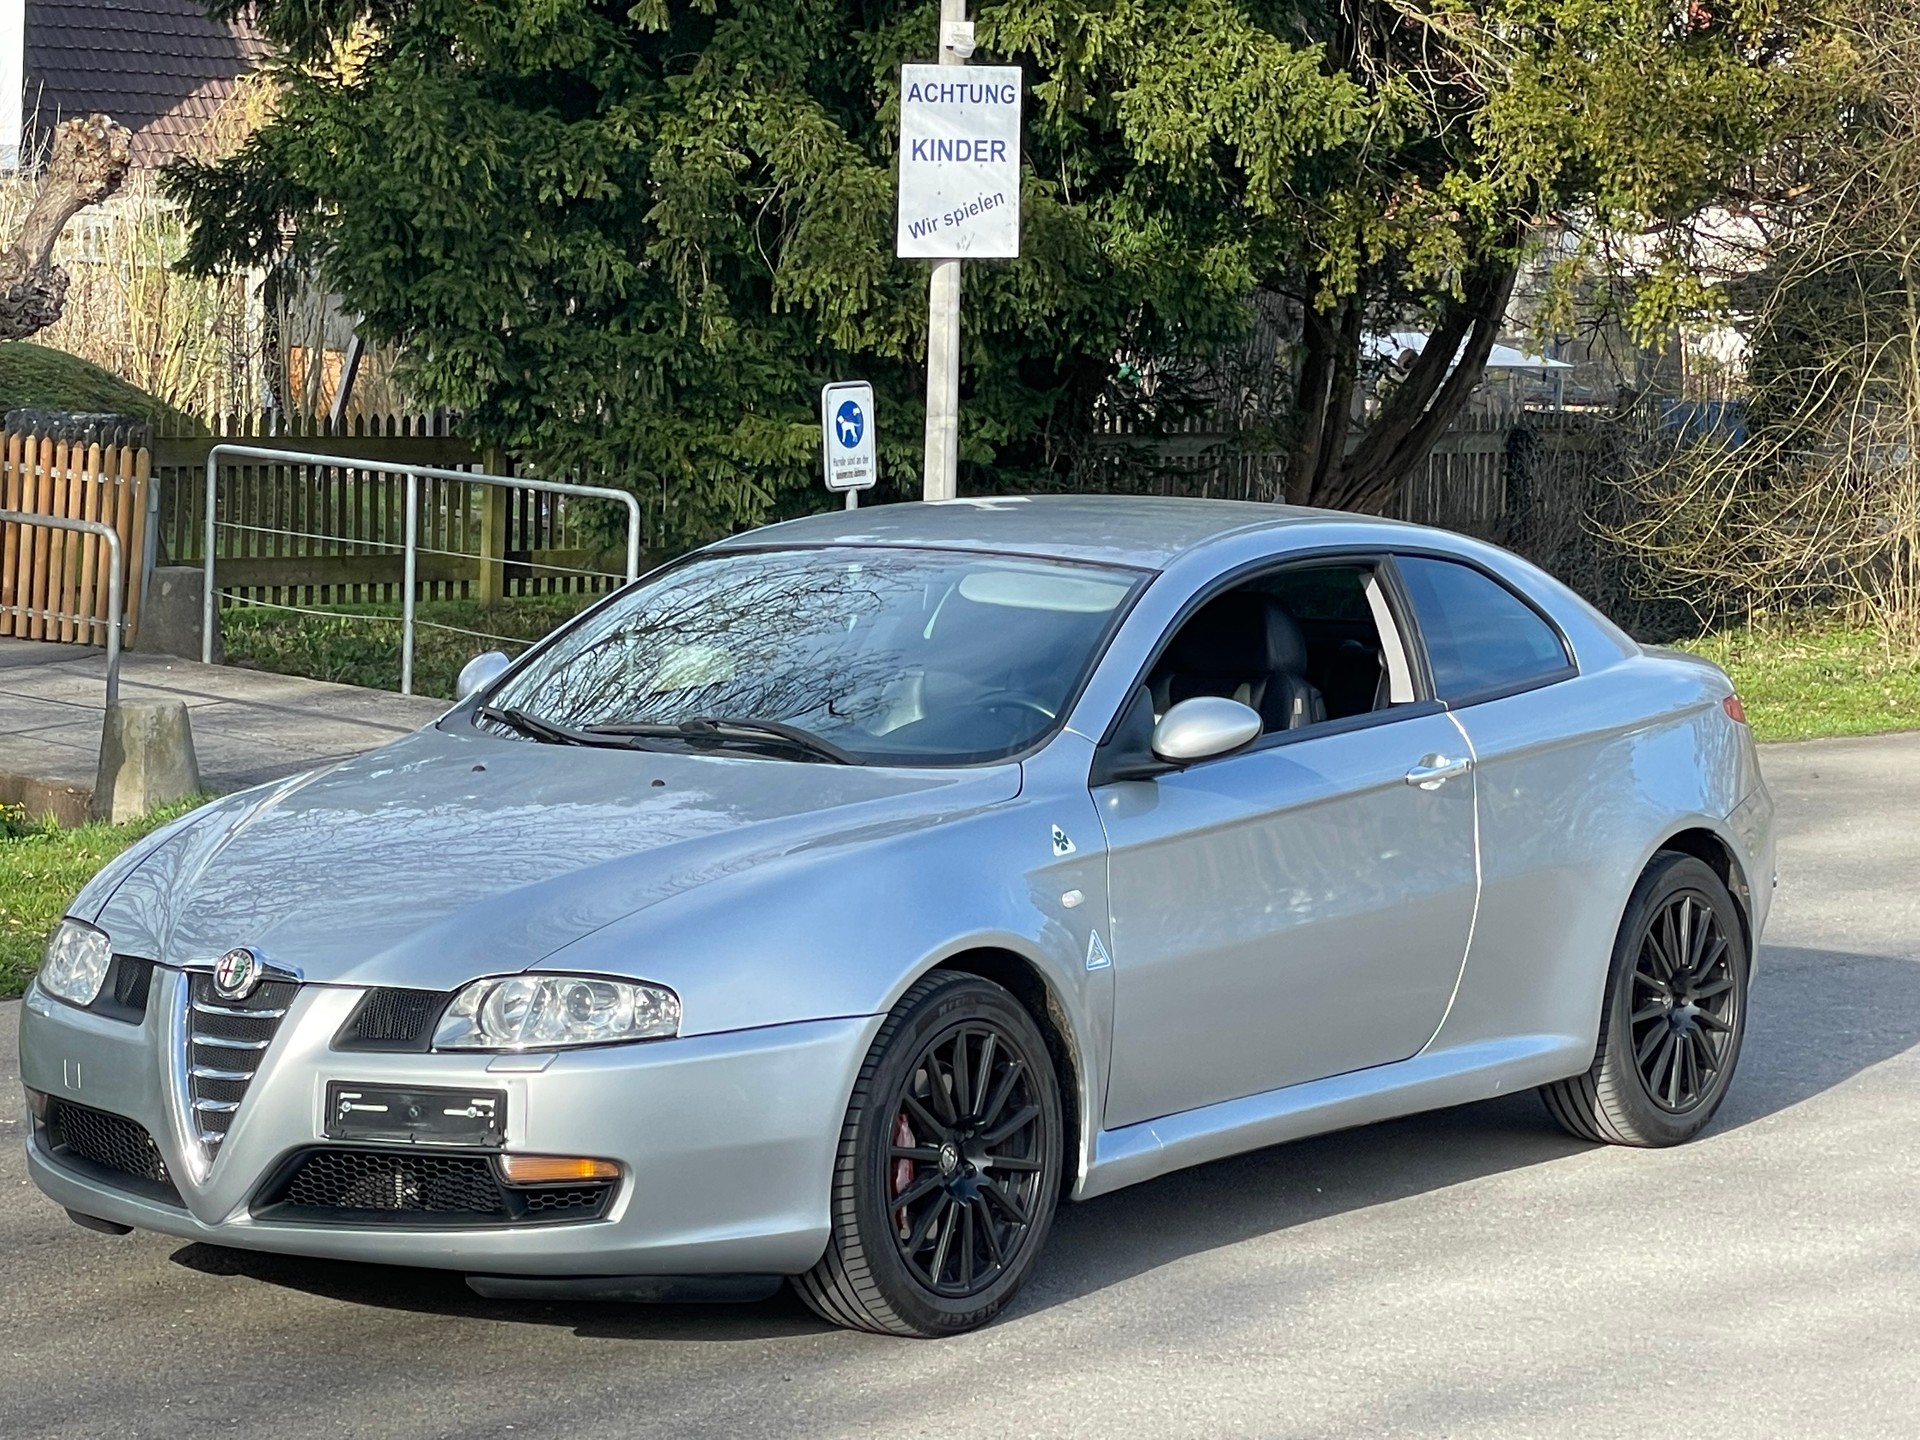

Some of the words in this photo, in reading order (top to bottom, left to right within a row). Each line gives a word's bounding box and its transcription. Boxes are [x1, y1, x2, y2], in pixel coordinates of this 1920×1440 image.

[907, 83, 1016, 104] ACHTUNG
[912, 139, 1007, 162] KINDER
[908, 217, 938, 239] Wir
[943, 192, 1005, 227] spielen
[937, 1299, 999, 1326] NEXEN
